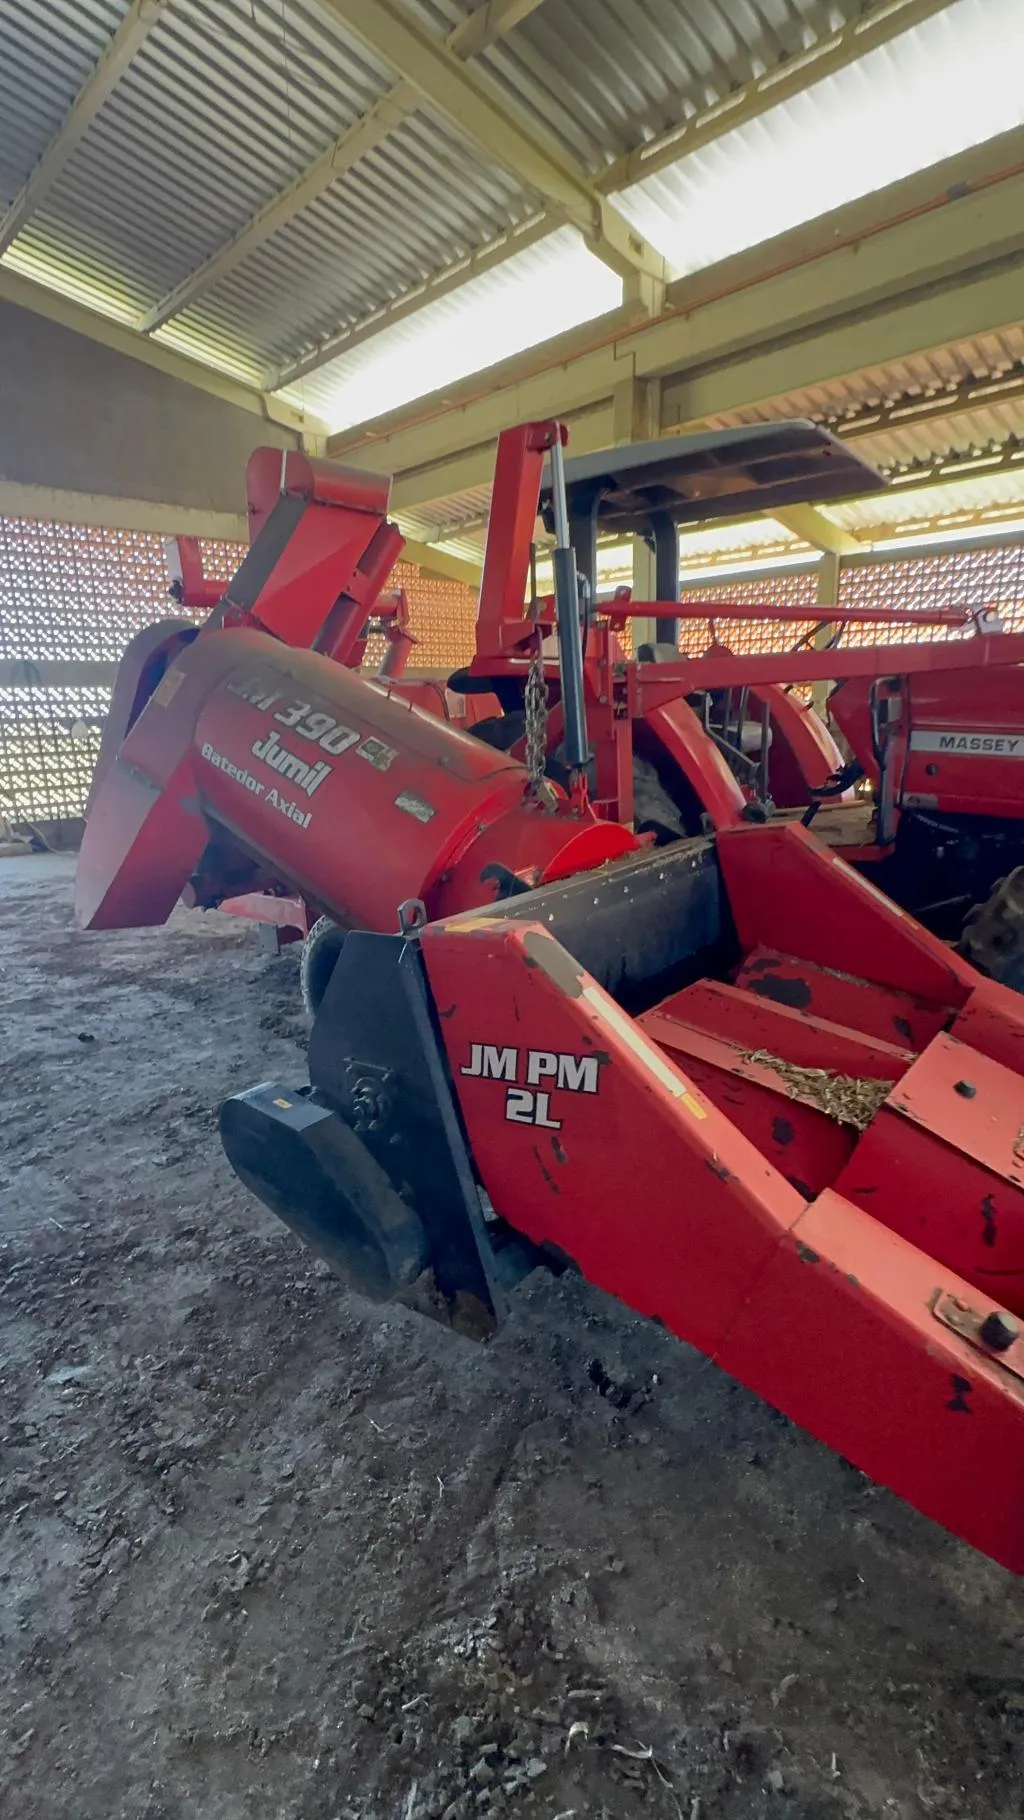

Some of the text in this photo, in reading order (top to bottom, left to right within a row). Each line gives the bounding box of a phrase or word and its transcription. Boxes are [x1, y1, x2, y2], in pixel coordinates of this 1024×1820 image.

[274, 699, 360, 755] 390
[939, 736, 1019, 752] MASSEY
[201, 742, 313, 829] Batedor Axial
[251, 730, 333, 797] Jumil
[460, 1043, 599, 1093] JM PM
[505, 1087, 562, 1129] 2L
